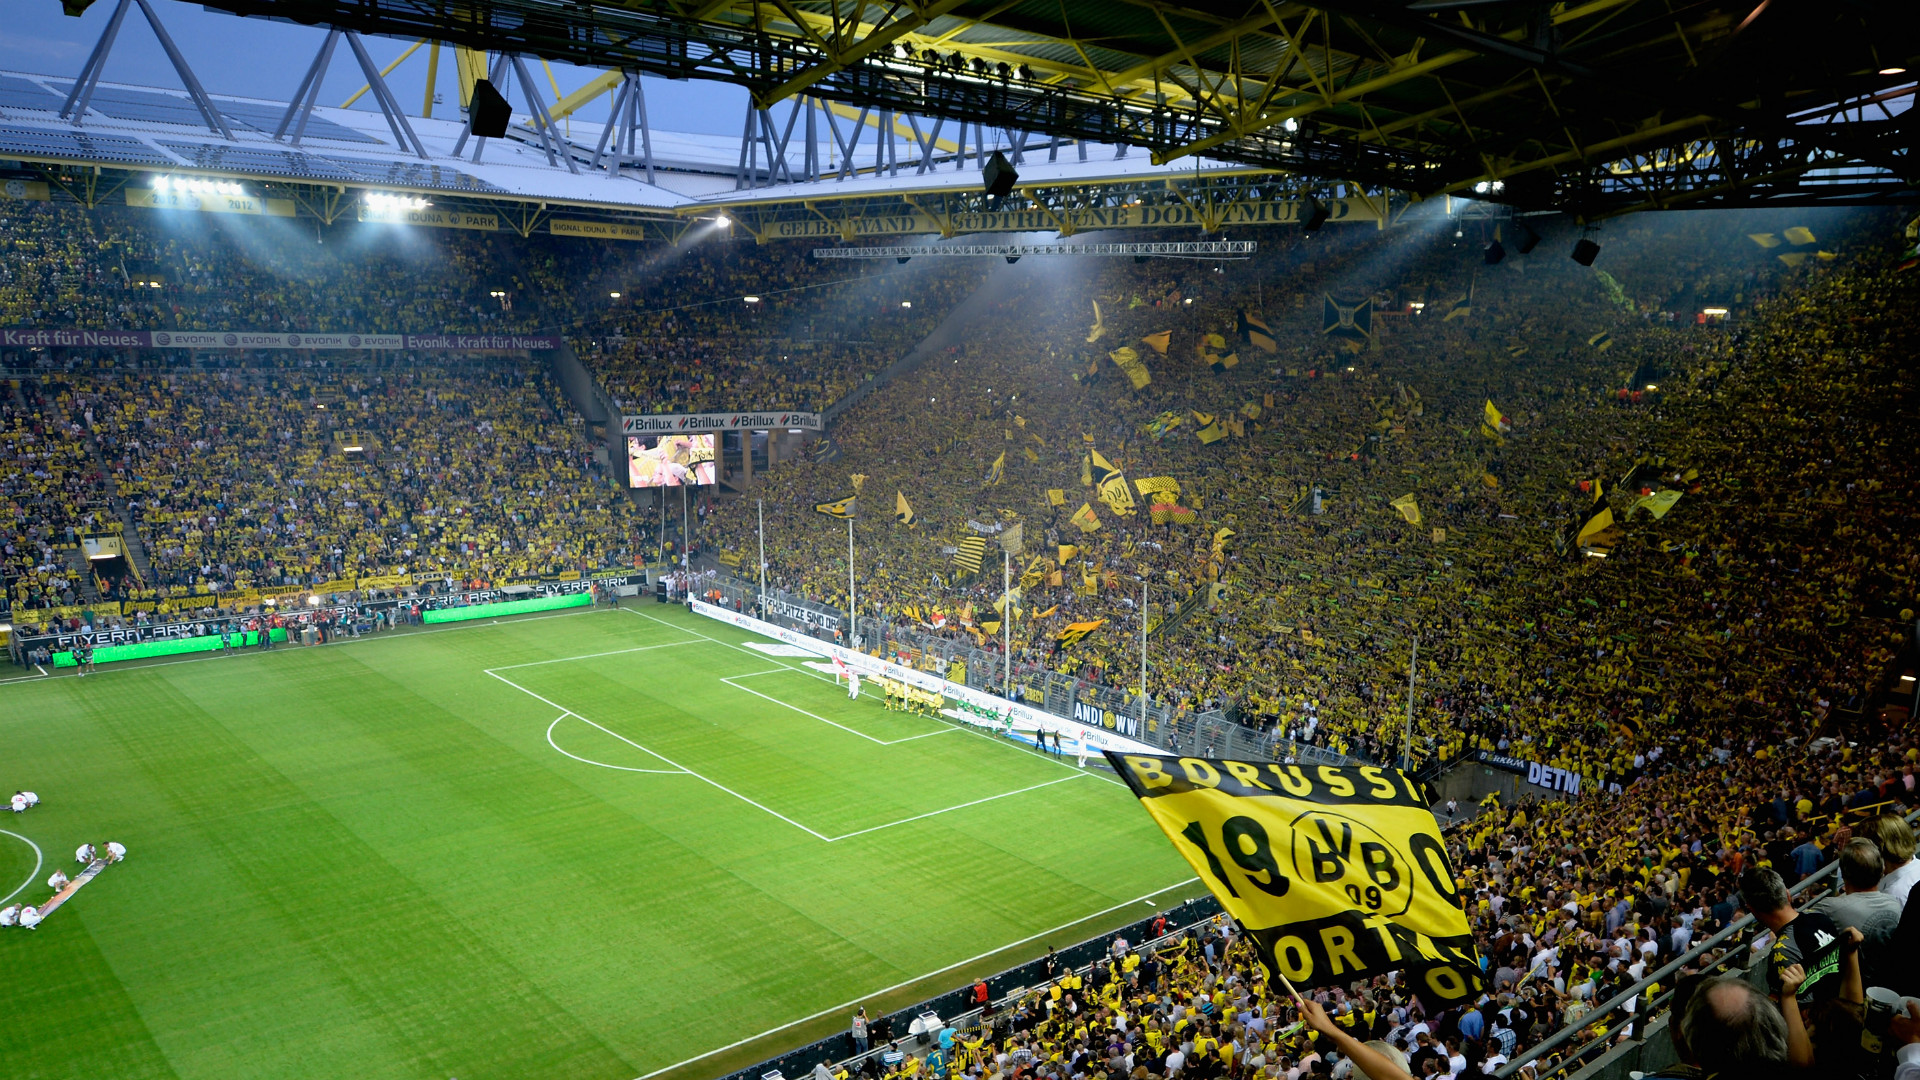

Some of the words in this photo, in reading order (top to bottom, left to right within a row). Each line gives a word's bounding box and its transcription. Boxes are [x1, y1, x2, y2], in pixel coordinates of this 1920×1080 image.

[228, 199, 254, 211] 2012
[408, 213, 443, 224] IDUNA
[466, 216, 495, 228] PARK
[856, 214, 916, 233] WAND
[1140, 200, 1350, 226] DORTMUD
[553, 222, 582, 233] SIGNAL
[583, 225, 607, 235] IDUNA
[621, 227, 641, 237] PARK
[4, 330, 51, 345] Kraft
[53, 331, 80, 346] für
[84, 332, 143, 347] Neues.
[408, 336, 455, 348] Evonik.
[458, 337, 489, 348] Kraft
[491, 337, 510, 348] für
[512, 338, 554, 349] Neues.
[635, 418, 672, 430] Brillux
[690, 417, 725, 429] Brillux
[741, 415, 775, 427] Brillux
[791, 415, 818, 427] Brillux
[887, 666, 904, 679] Brillux
[947, 685, 965, 698] Brillux
[1013, 708, 1033, 721] Brillux
[1086, 731, 1109, 746] Brillux
[1074, 702, 1103, 727] ANDI
[1115, 714, 1137, 737] WW
[1344, 883, 1383, 909] 09
